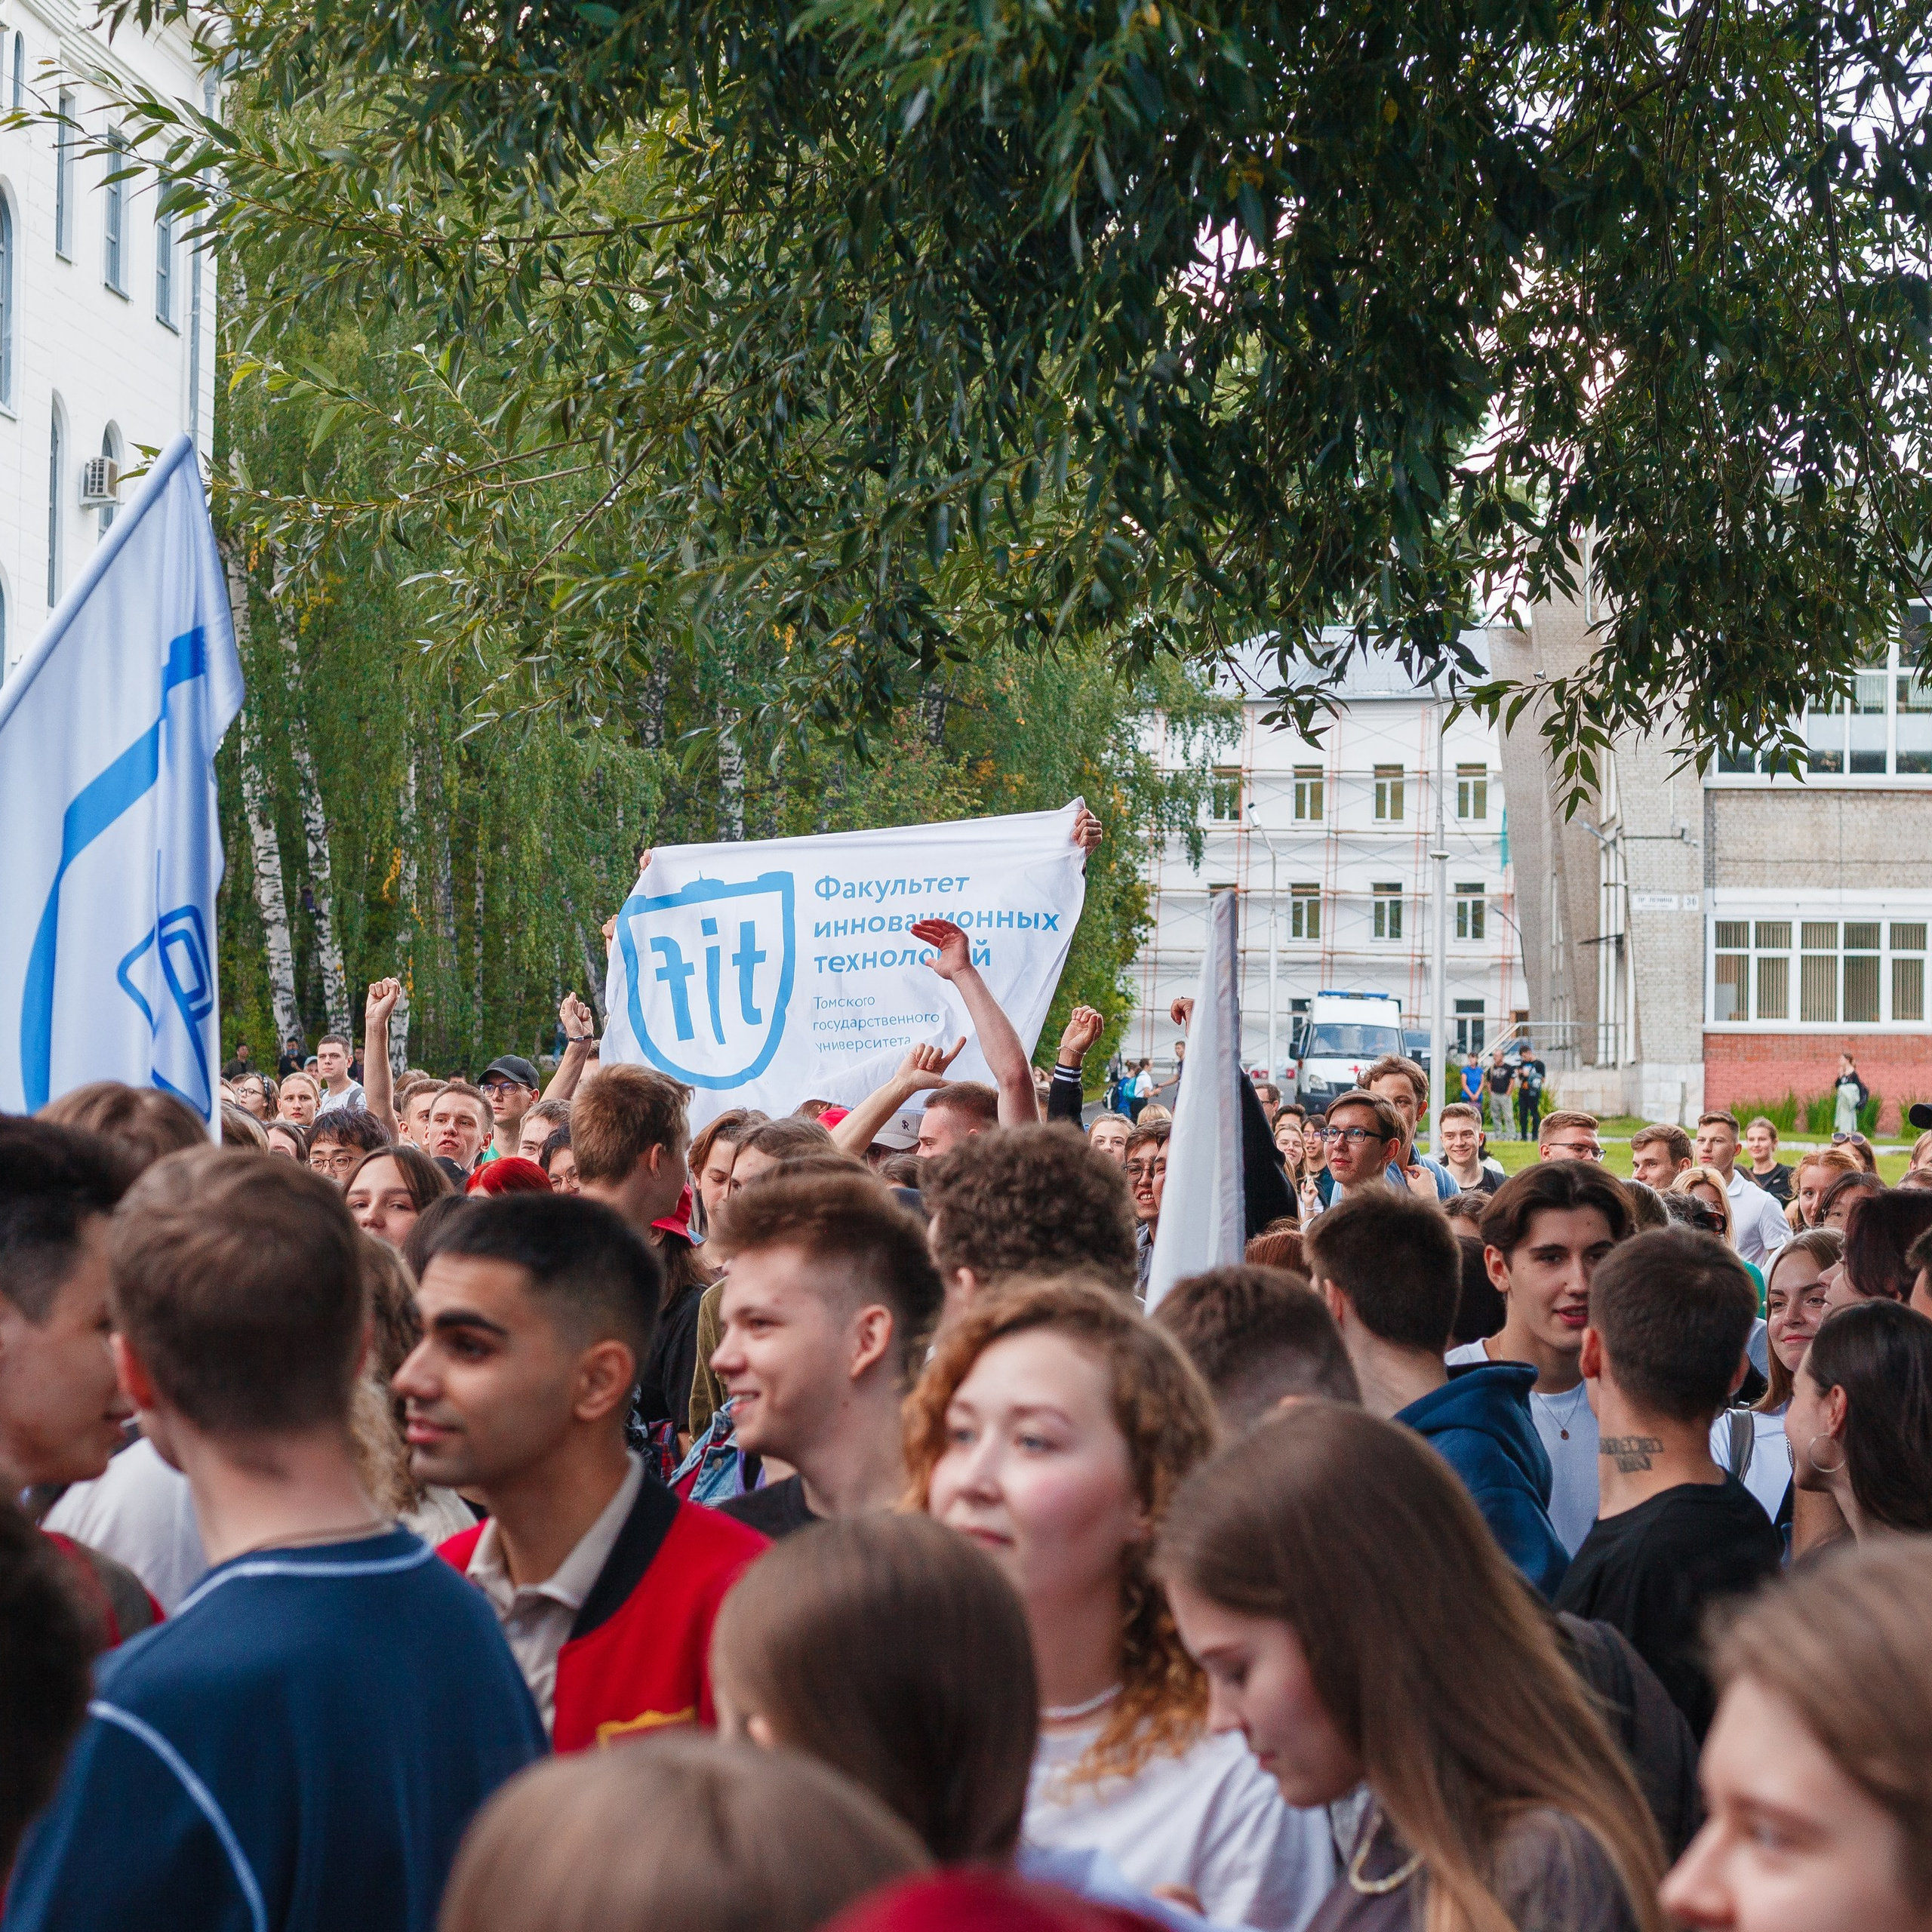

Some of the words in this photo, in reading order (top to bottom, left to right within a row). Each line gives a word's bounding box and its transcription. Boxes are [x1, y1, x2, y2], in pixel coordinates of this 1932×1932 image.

[814, 875, 970, 903] Факультет
[814, 939, 991, 974] технолой
[650, 918, 767, 1045] fit
[814, 995, 875, 1010] Томского
[813, 1013, 940, 1032] государственного
[815, 1035, 911, 1053] университета
